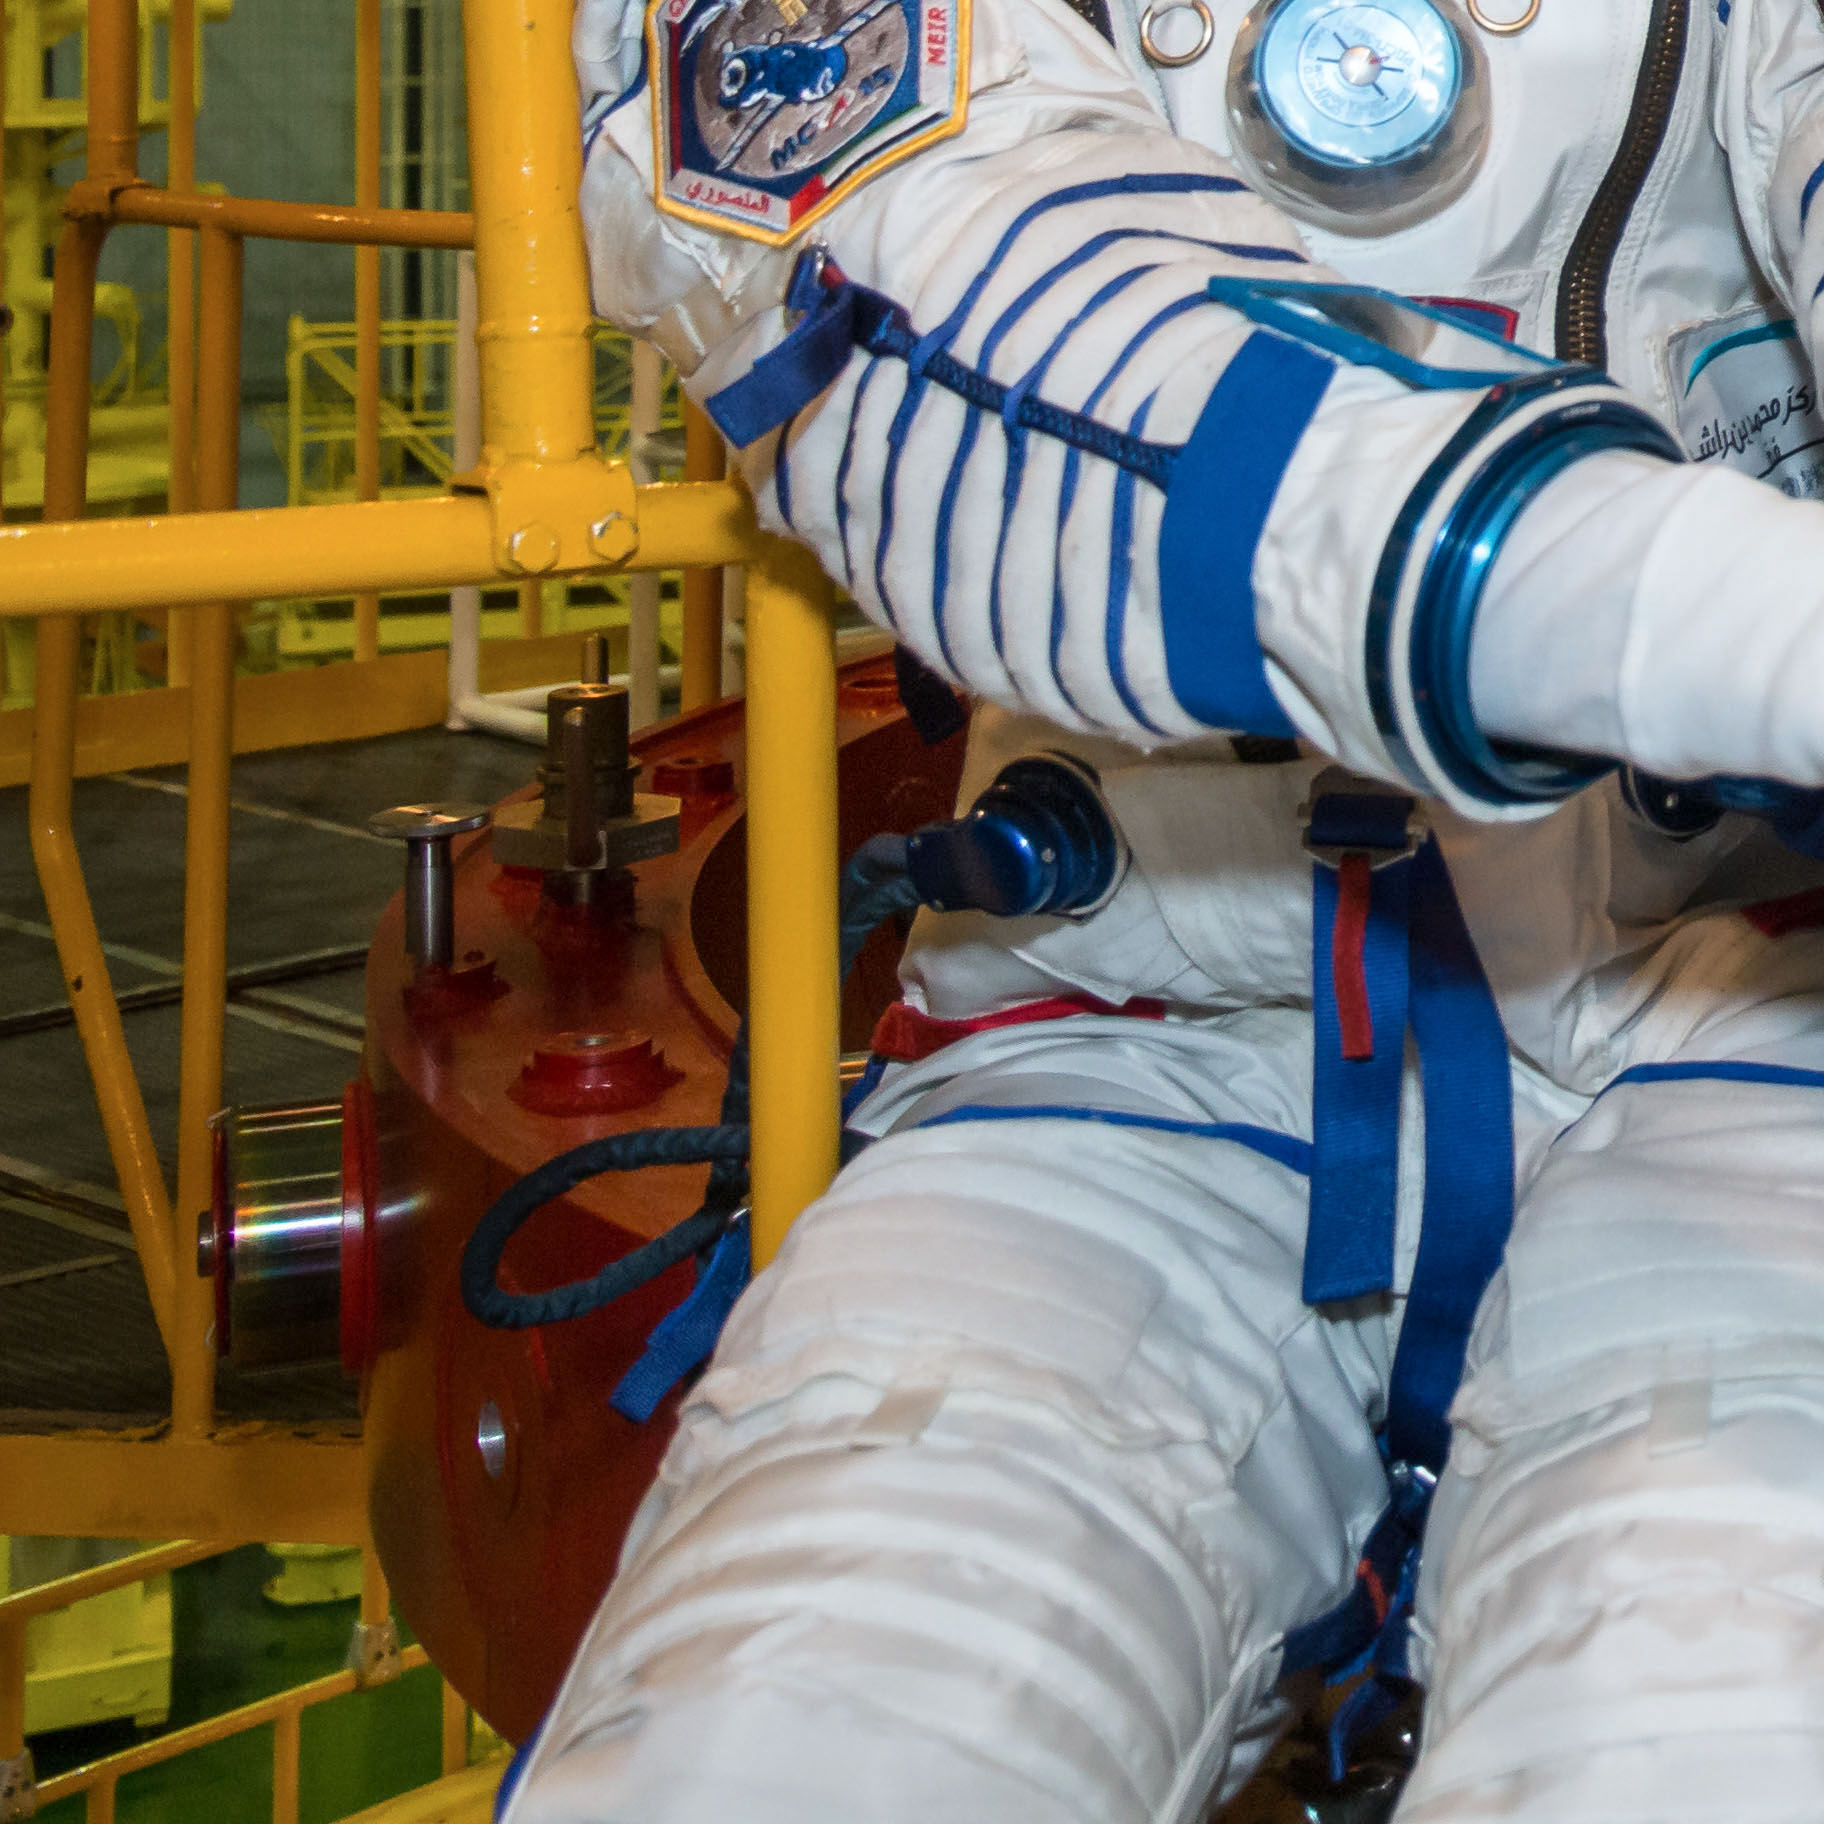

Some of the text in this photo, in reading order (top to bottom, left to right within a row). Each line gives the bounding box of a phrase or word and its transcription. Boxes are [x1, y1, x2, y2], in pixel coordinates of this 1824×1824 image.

[926, 6, 949, 68] MEIR
[1782, 385, 1816, 426] ركز
[1692, 418, 1733, 462] راش
